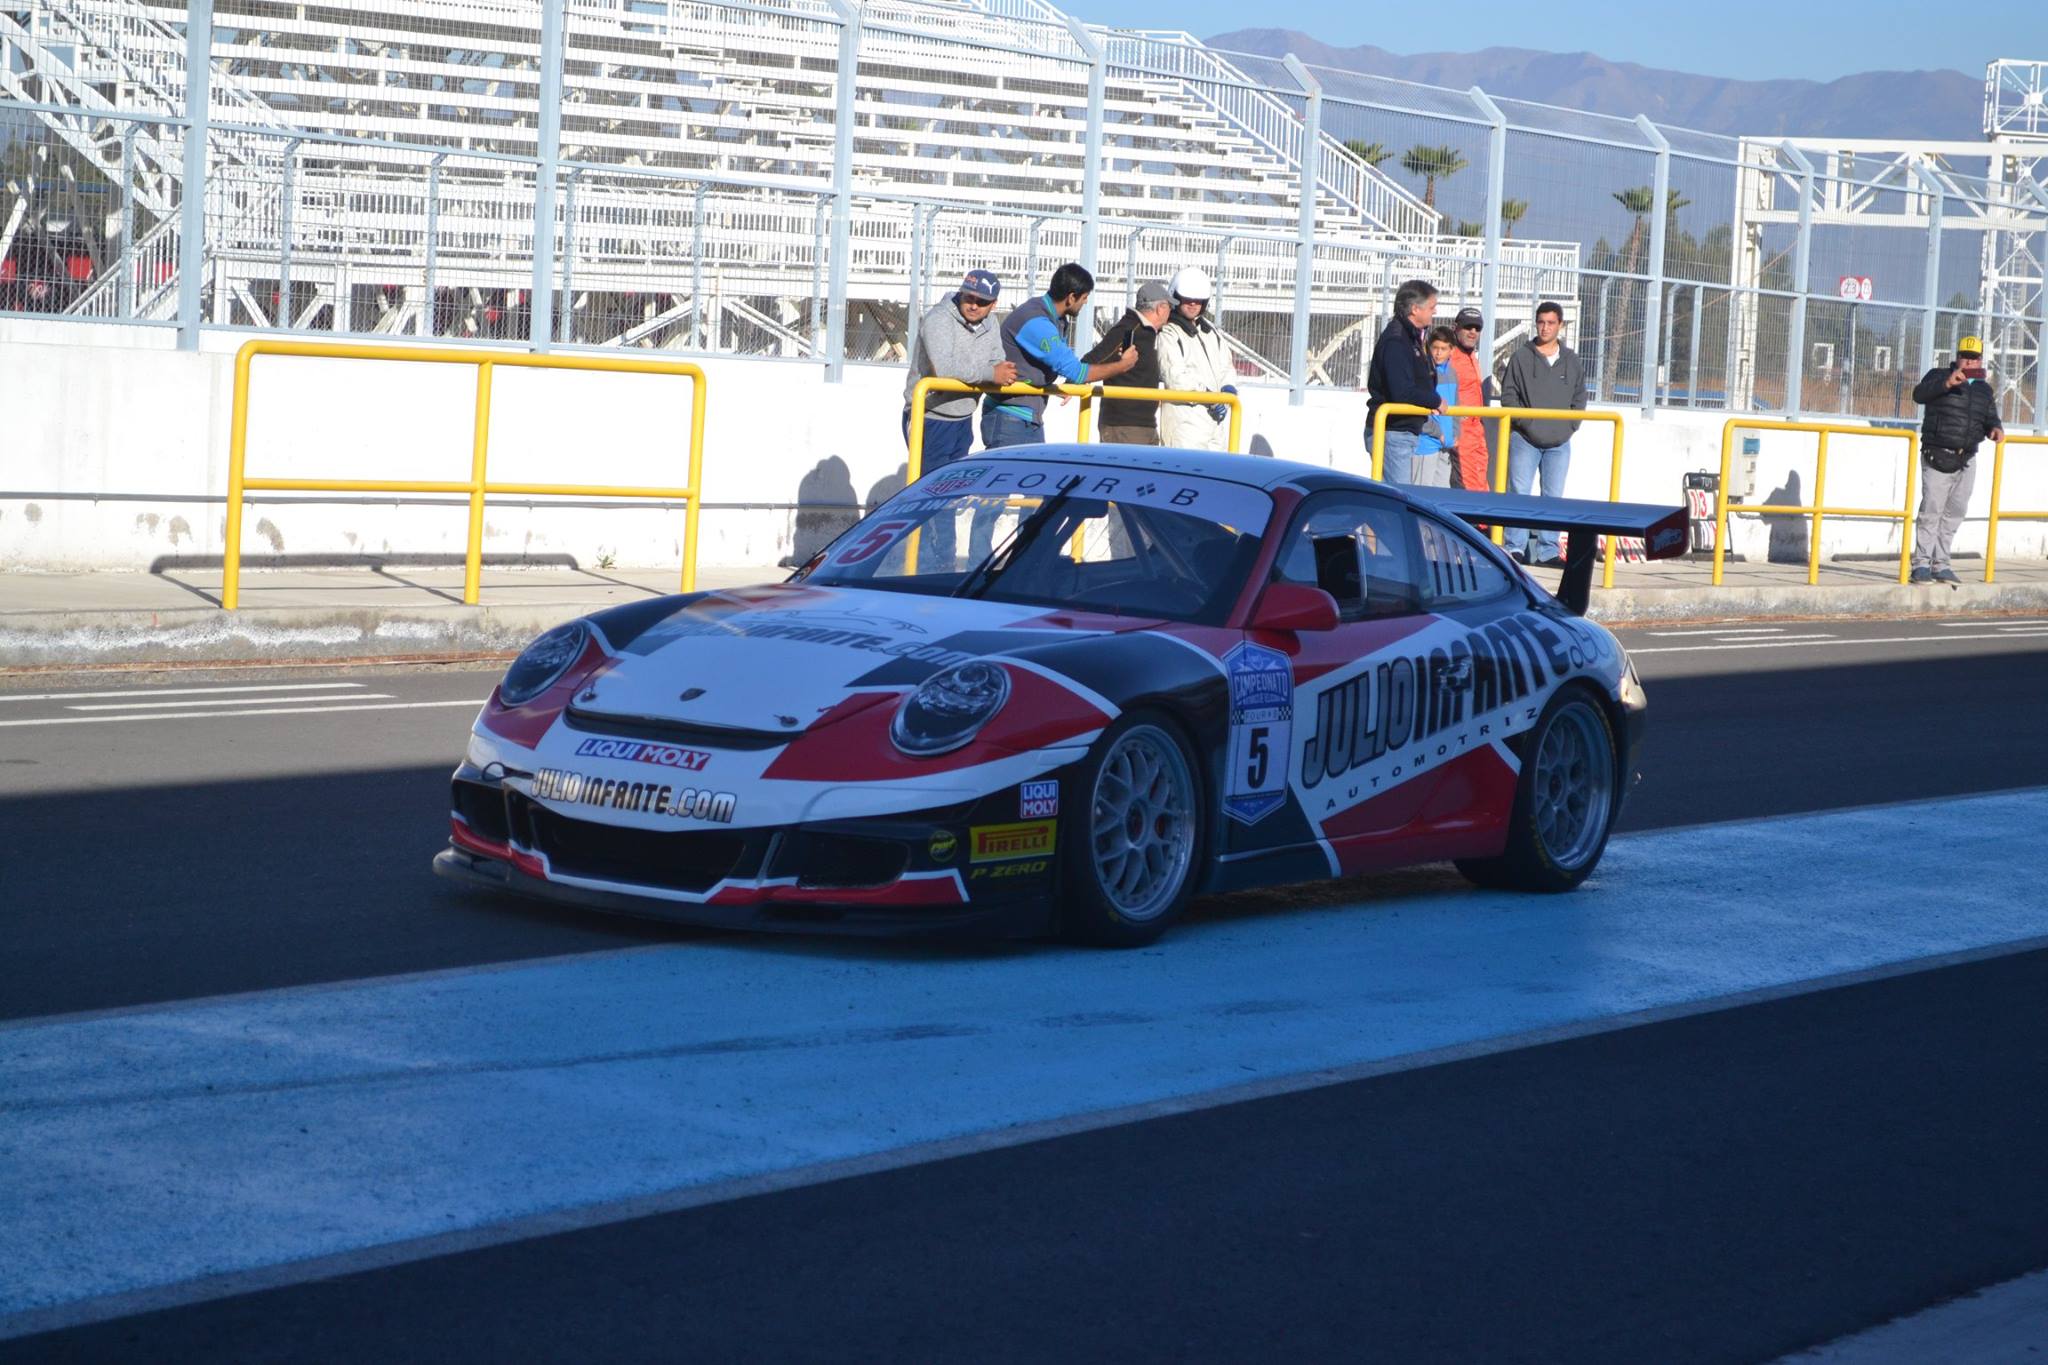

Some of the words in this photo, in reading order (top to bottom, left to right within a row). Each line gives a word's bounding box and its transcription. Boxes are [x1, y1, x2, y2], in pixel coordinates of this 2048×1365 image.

[942, 468, 983, 481] TAG
[986, 473, 1121, 494] FOUR
[1170, 487, 1200, 507] B
[835, 520, 913, 566] 5
[1233, 672, 1289, 701] CAMPEONATO
[578, 739, 636, 760] LIQUI
[639, 744, 710, 770] MOLY
[1247, 727, 1269, 789] 5
[1326, 706, 1538, 811] AUTOMOTRIZ
[531, 768, 738, 824] JULIOINFANTE.COM
[1023, 781, 1057, 800] LIQUI
[1023, 799, 1057, 816] MOLY
[977, 825, 1050, 854] PIRELLI
[969, 868, 988, 879] P
[989, 861, 1048, 878] ZERO
